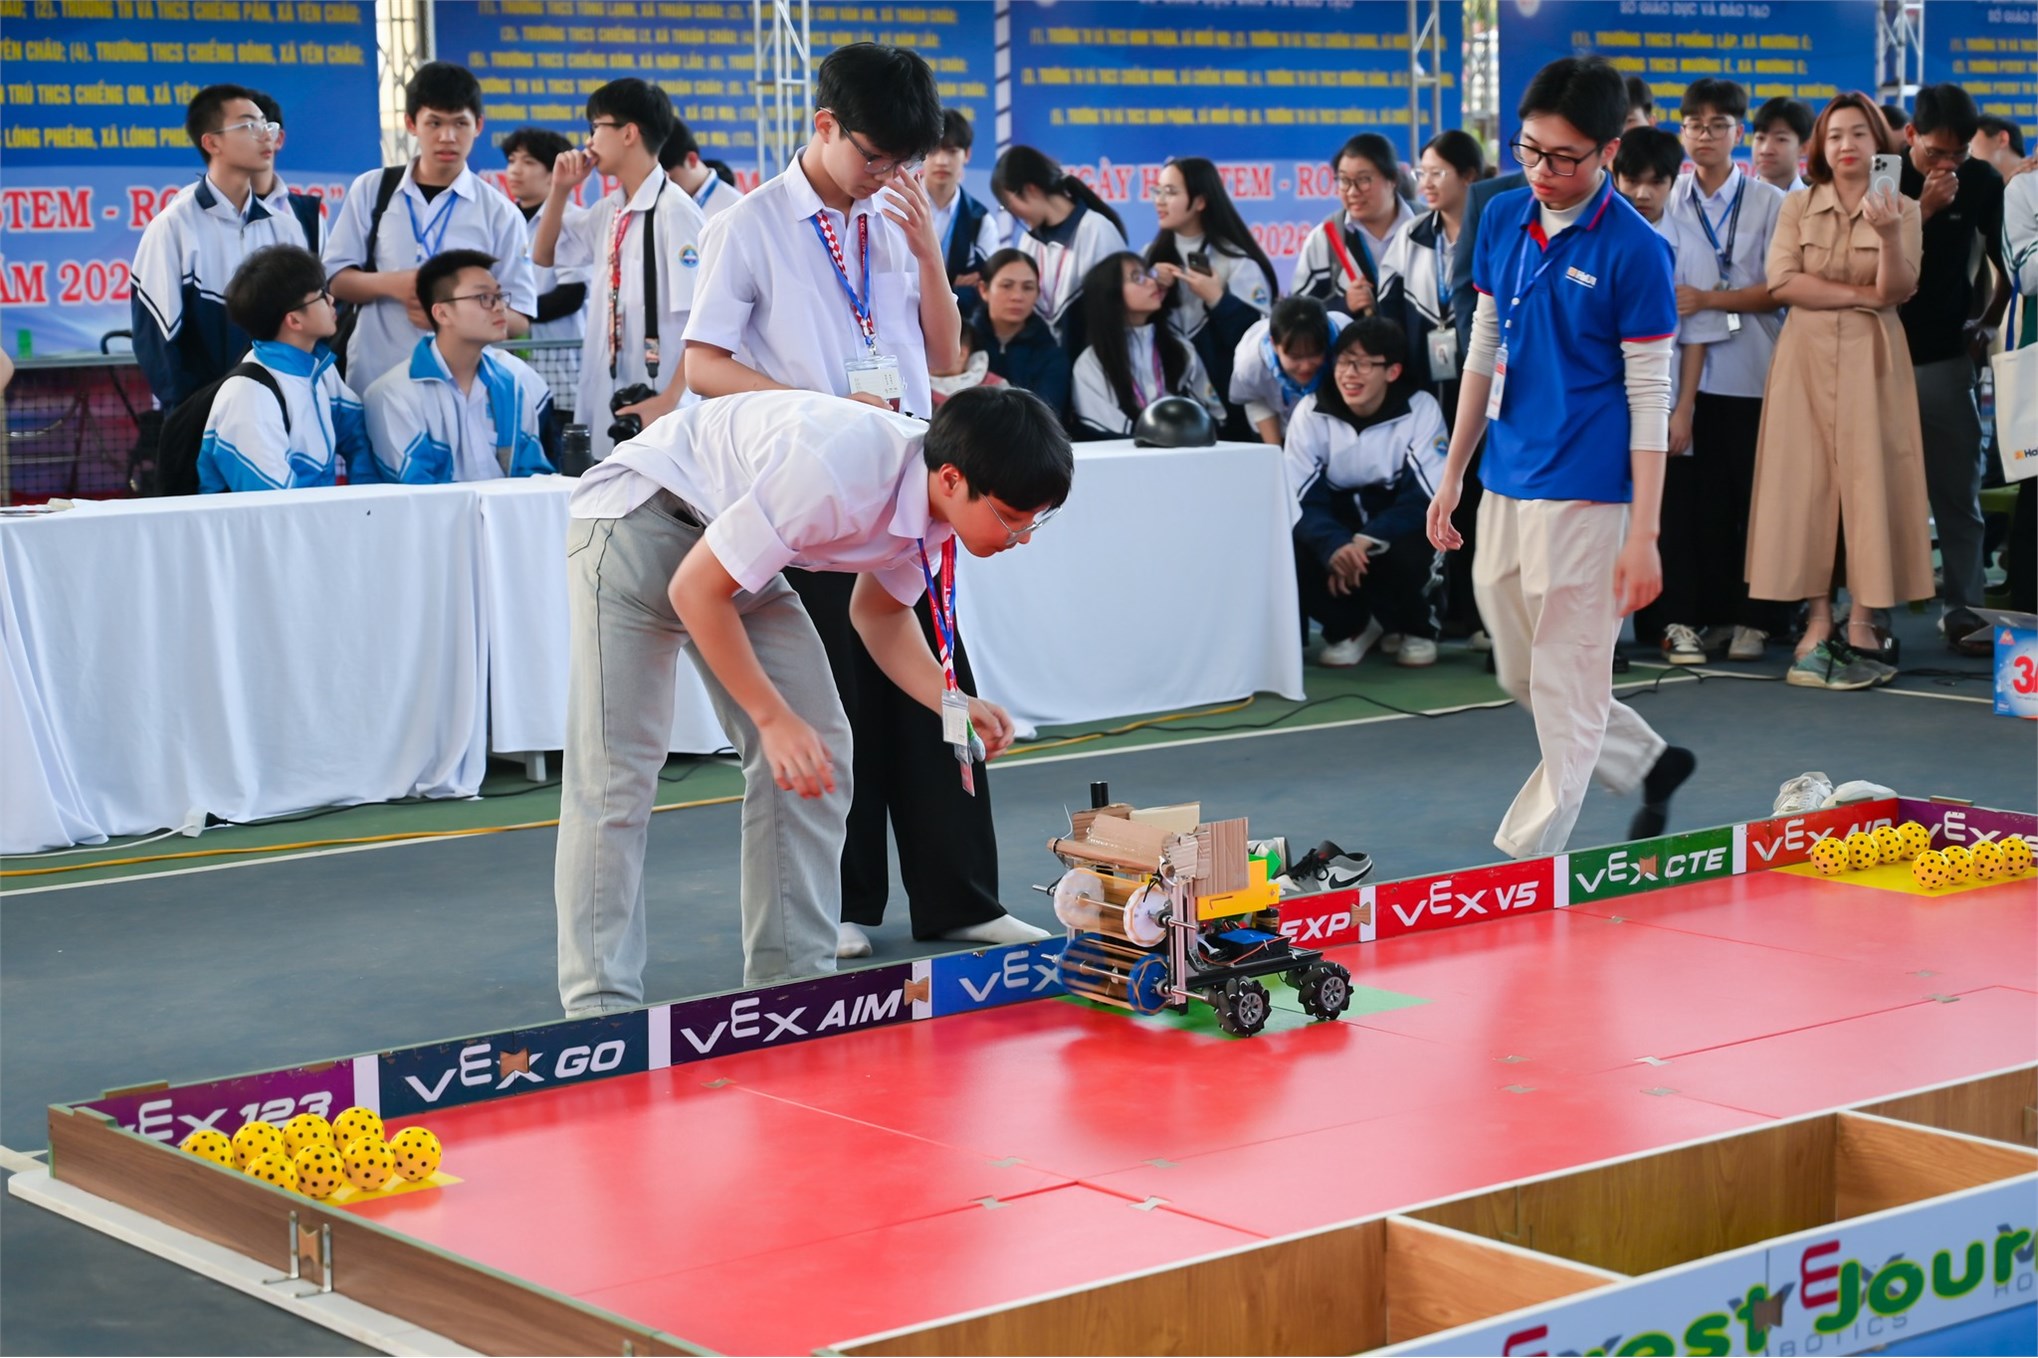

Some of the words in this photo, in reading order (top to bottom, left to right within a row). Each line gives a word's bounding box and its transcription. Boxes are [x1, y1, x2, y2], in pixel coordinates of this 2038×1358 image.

[151, 42, 184, 62] THCS
[38, 84, 72, 105] THCS
[1066, 157, 1132, 199] GÀY
[0, 187, 92, 229] TEM
[59, 261, 132, 303] 202
[1664, 847, 1728, 879] CTE
[1391, 880, 1489, 927] VEX
[1495, 881, 1540, 911] V5
[1279, 911, 1351, 944] EXP
[680, 997, 809, 1055] VEX
[816, 988, 904, 1032] AIM
[554, 1039, 627, 1079] GO
[124, 1098, 231, 1147] EX
[1815, 1227, 2038, 1336] Jour
